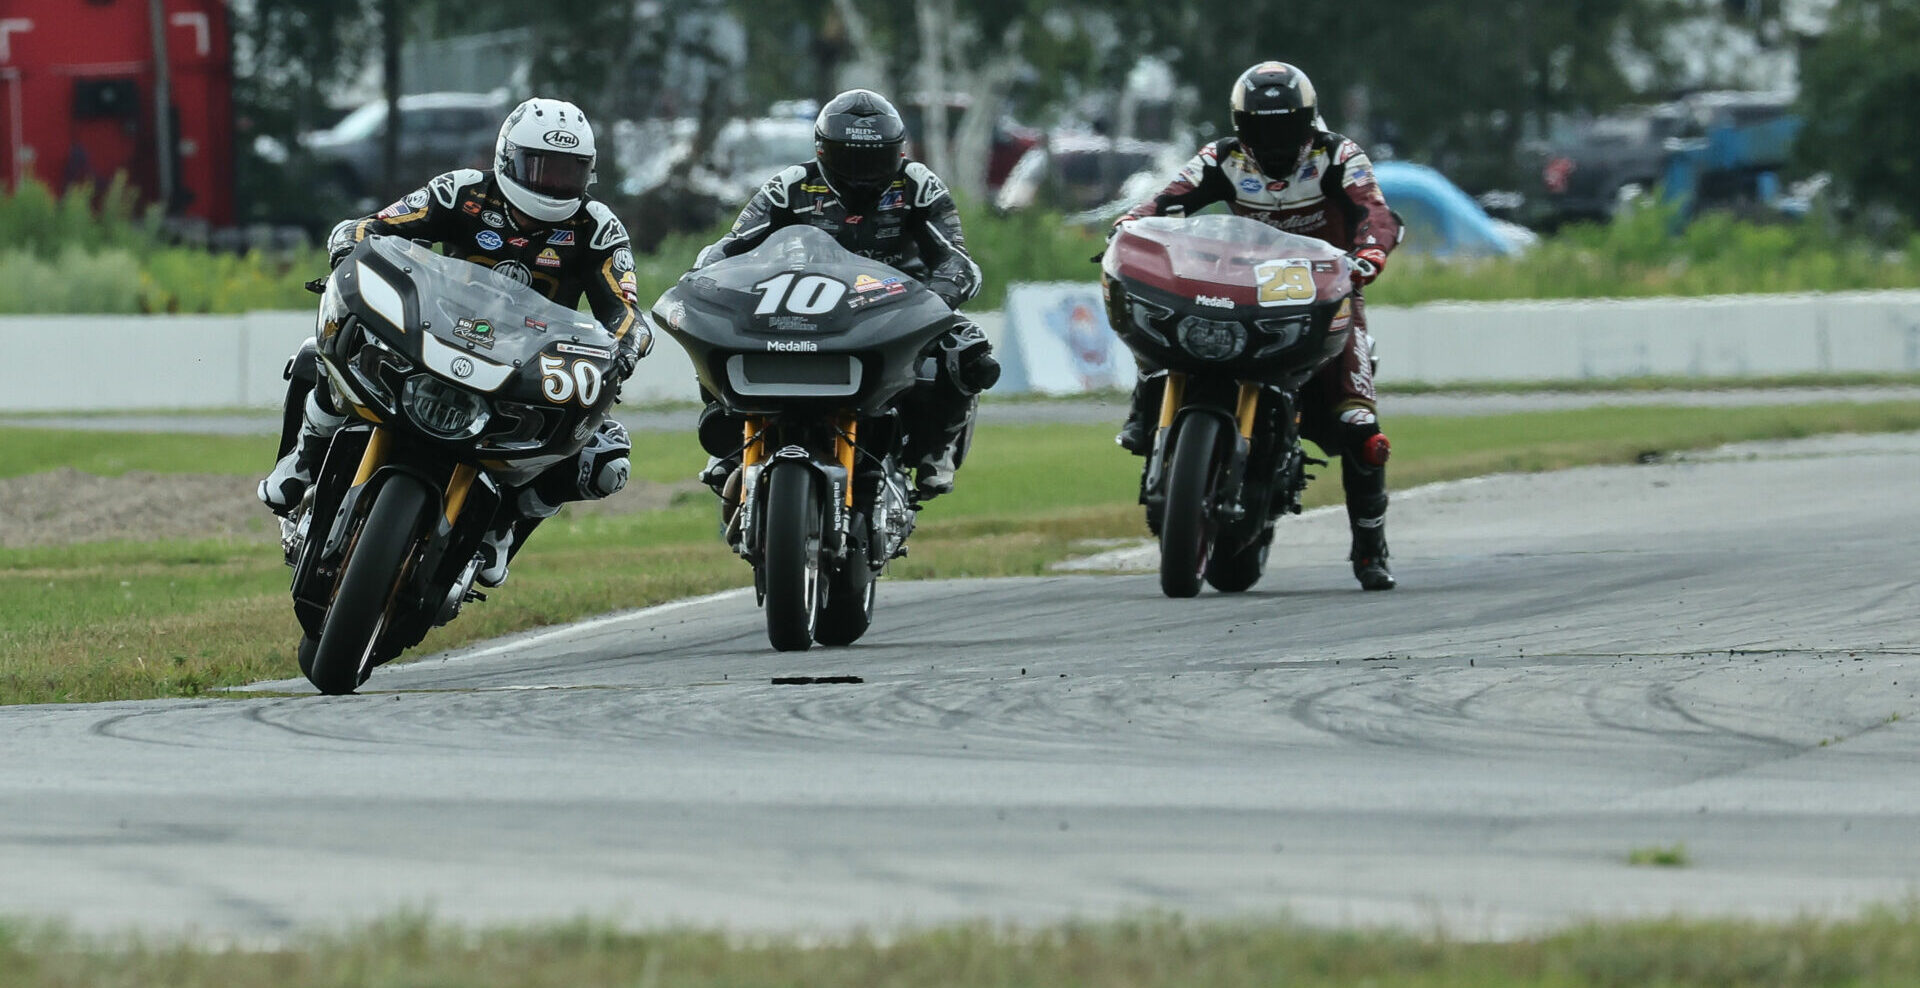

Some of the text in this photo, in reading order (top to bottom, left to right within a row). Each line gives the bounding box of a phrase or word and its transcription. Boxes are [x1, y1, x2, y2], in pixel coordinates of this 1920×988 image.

[546, 131, 576, 145] Arai
[754, 273, 847, 315] 10
[1259, 266, 1314, 302] 29
[1196, 295, 1235, 309] Medallia
[767, 341, 817, 352] Medallia
[540, 352, 602, 407] 50
